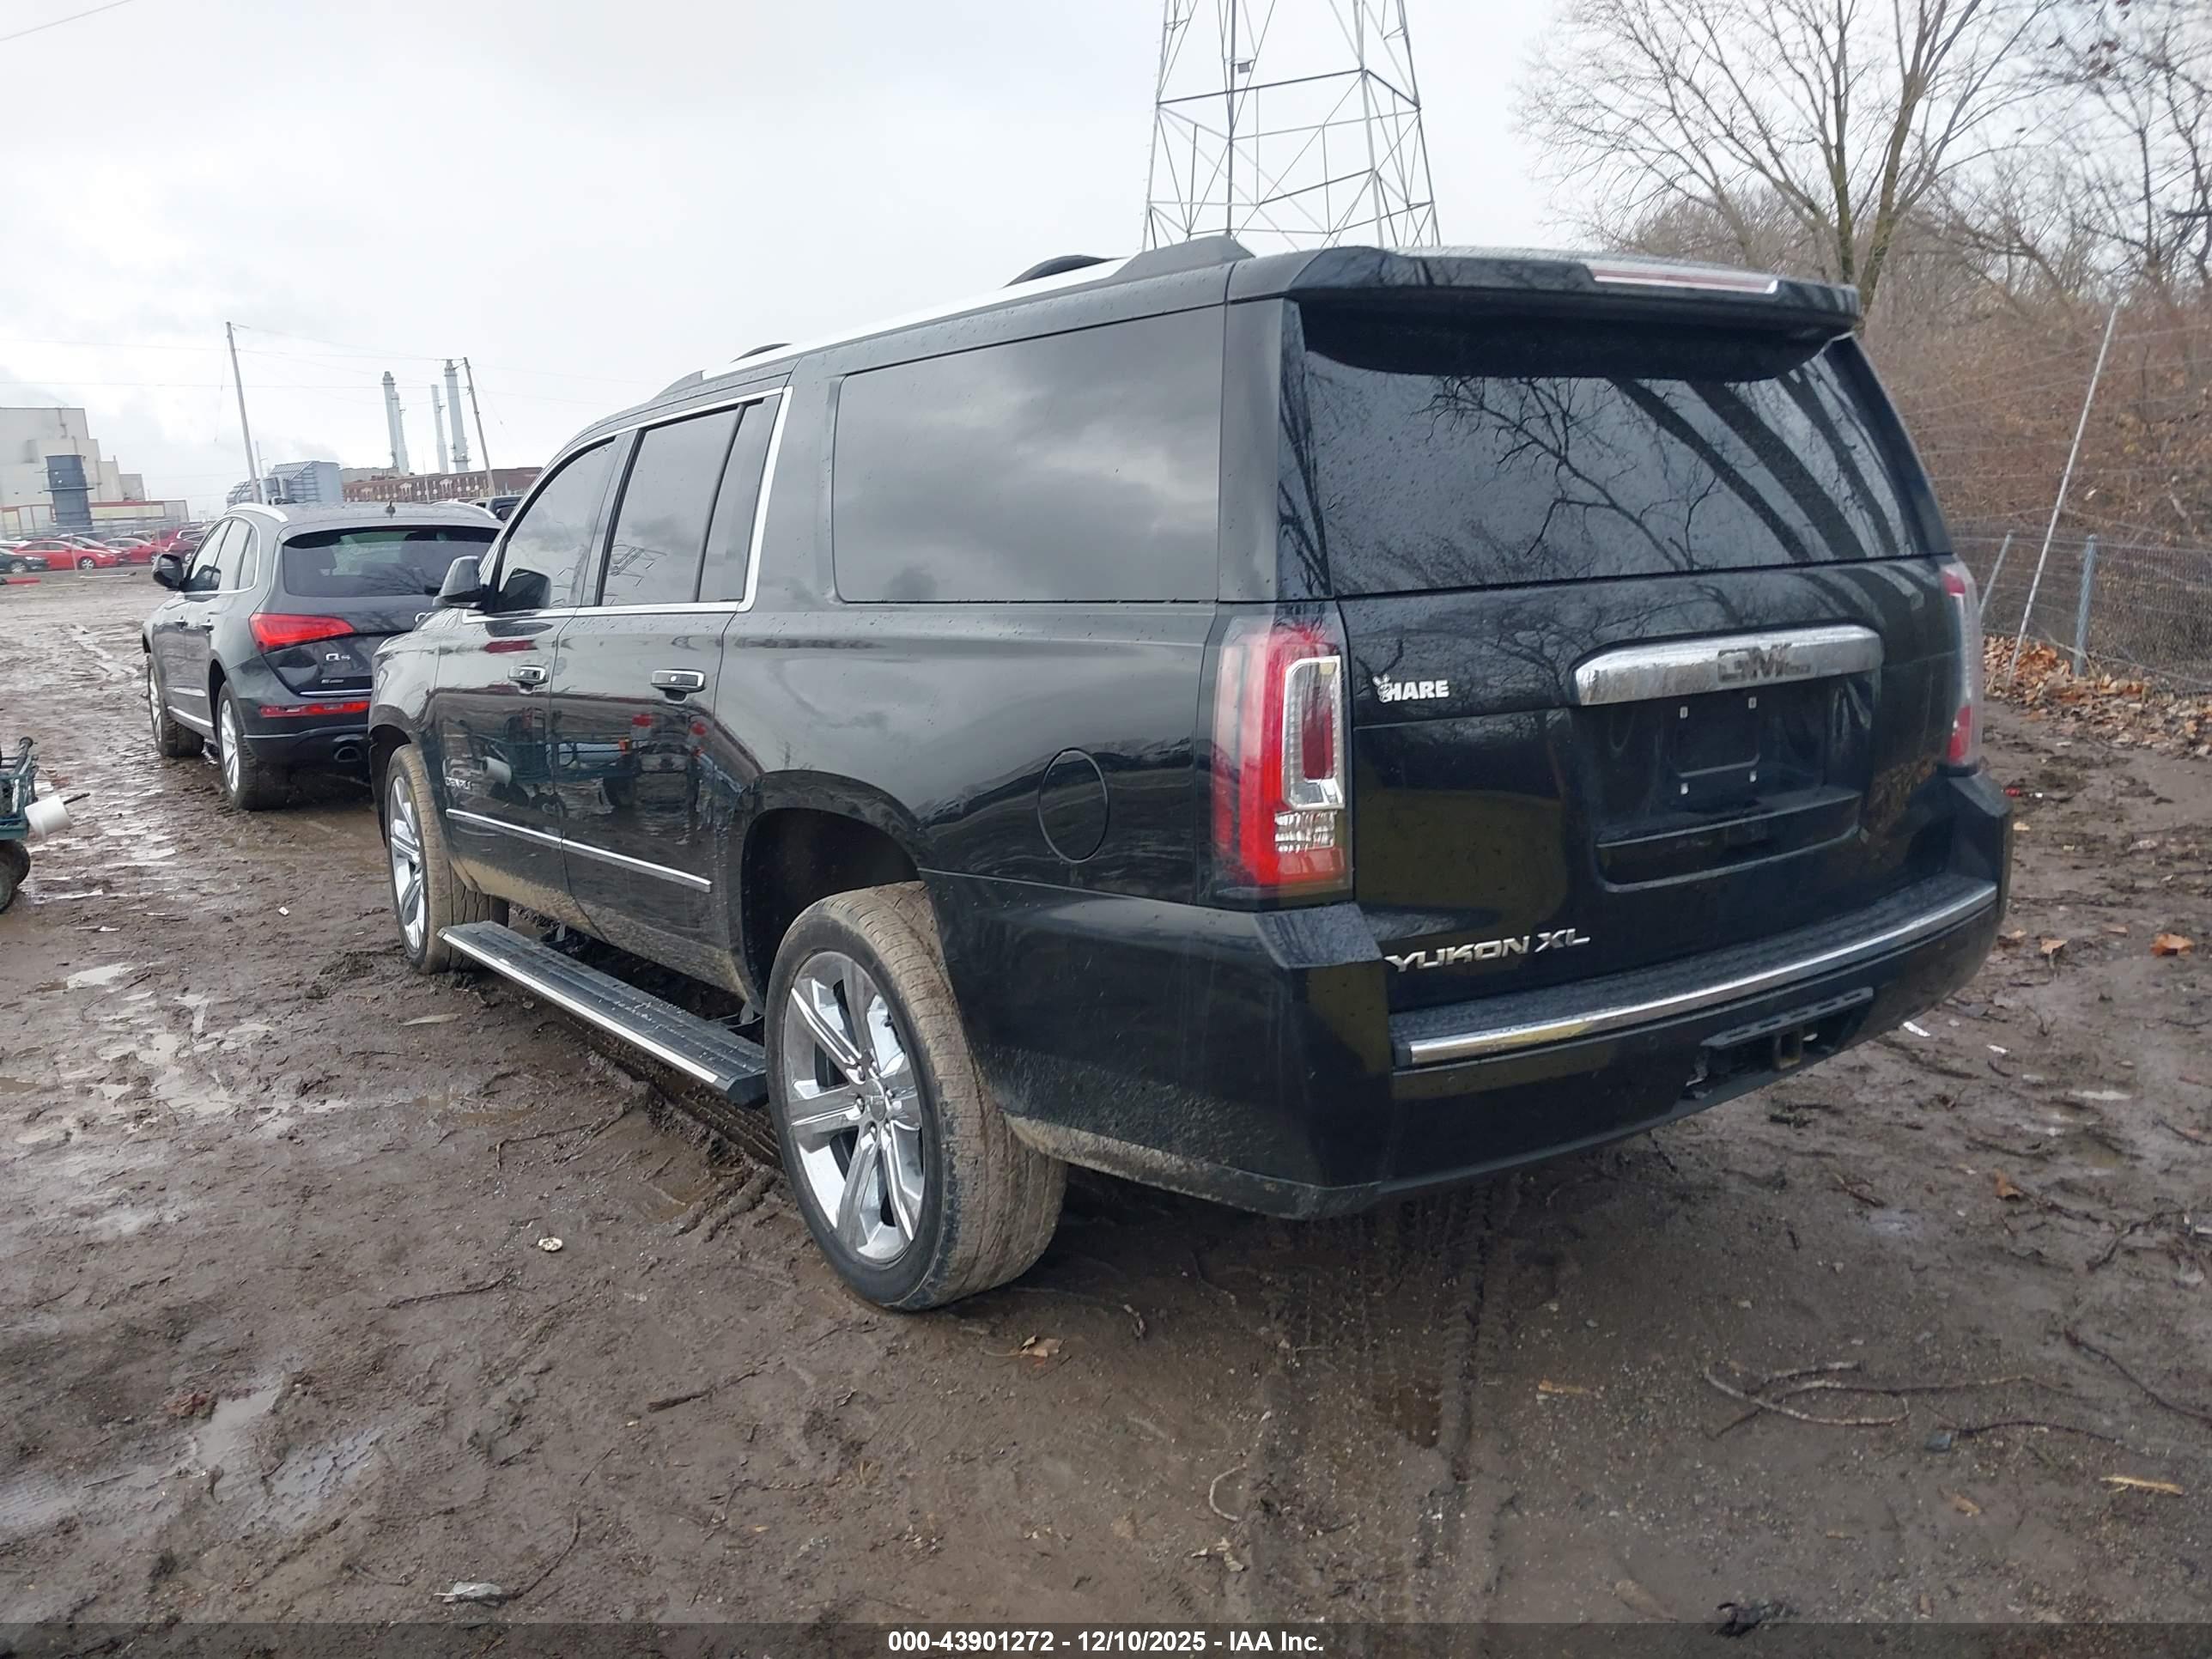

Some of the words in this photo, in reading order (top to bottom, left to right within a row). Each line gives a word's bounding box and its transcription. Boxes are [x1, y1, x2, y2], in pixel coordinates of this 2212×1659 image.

[325, 653, 350, 661] Q5
[1384, 678, 1450, 702] HARE
[1383, 934, 1531, 973] YUKON
[1534, 927, 1591, 953] XL
